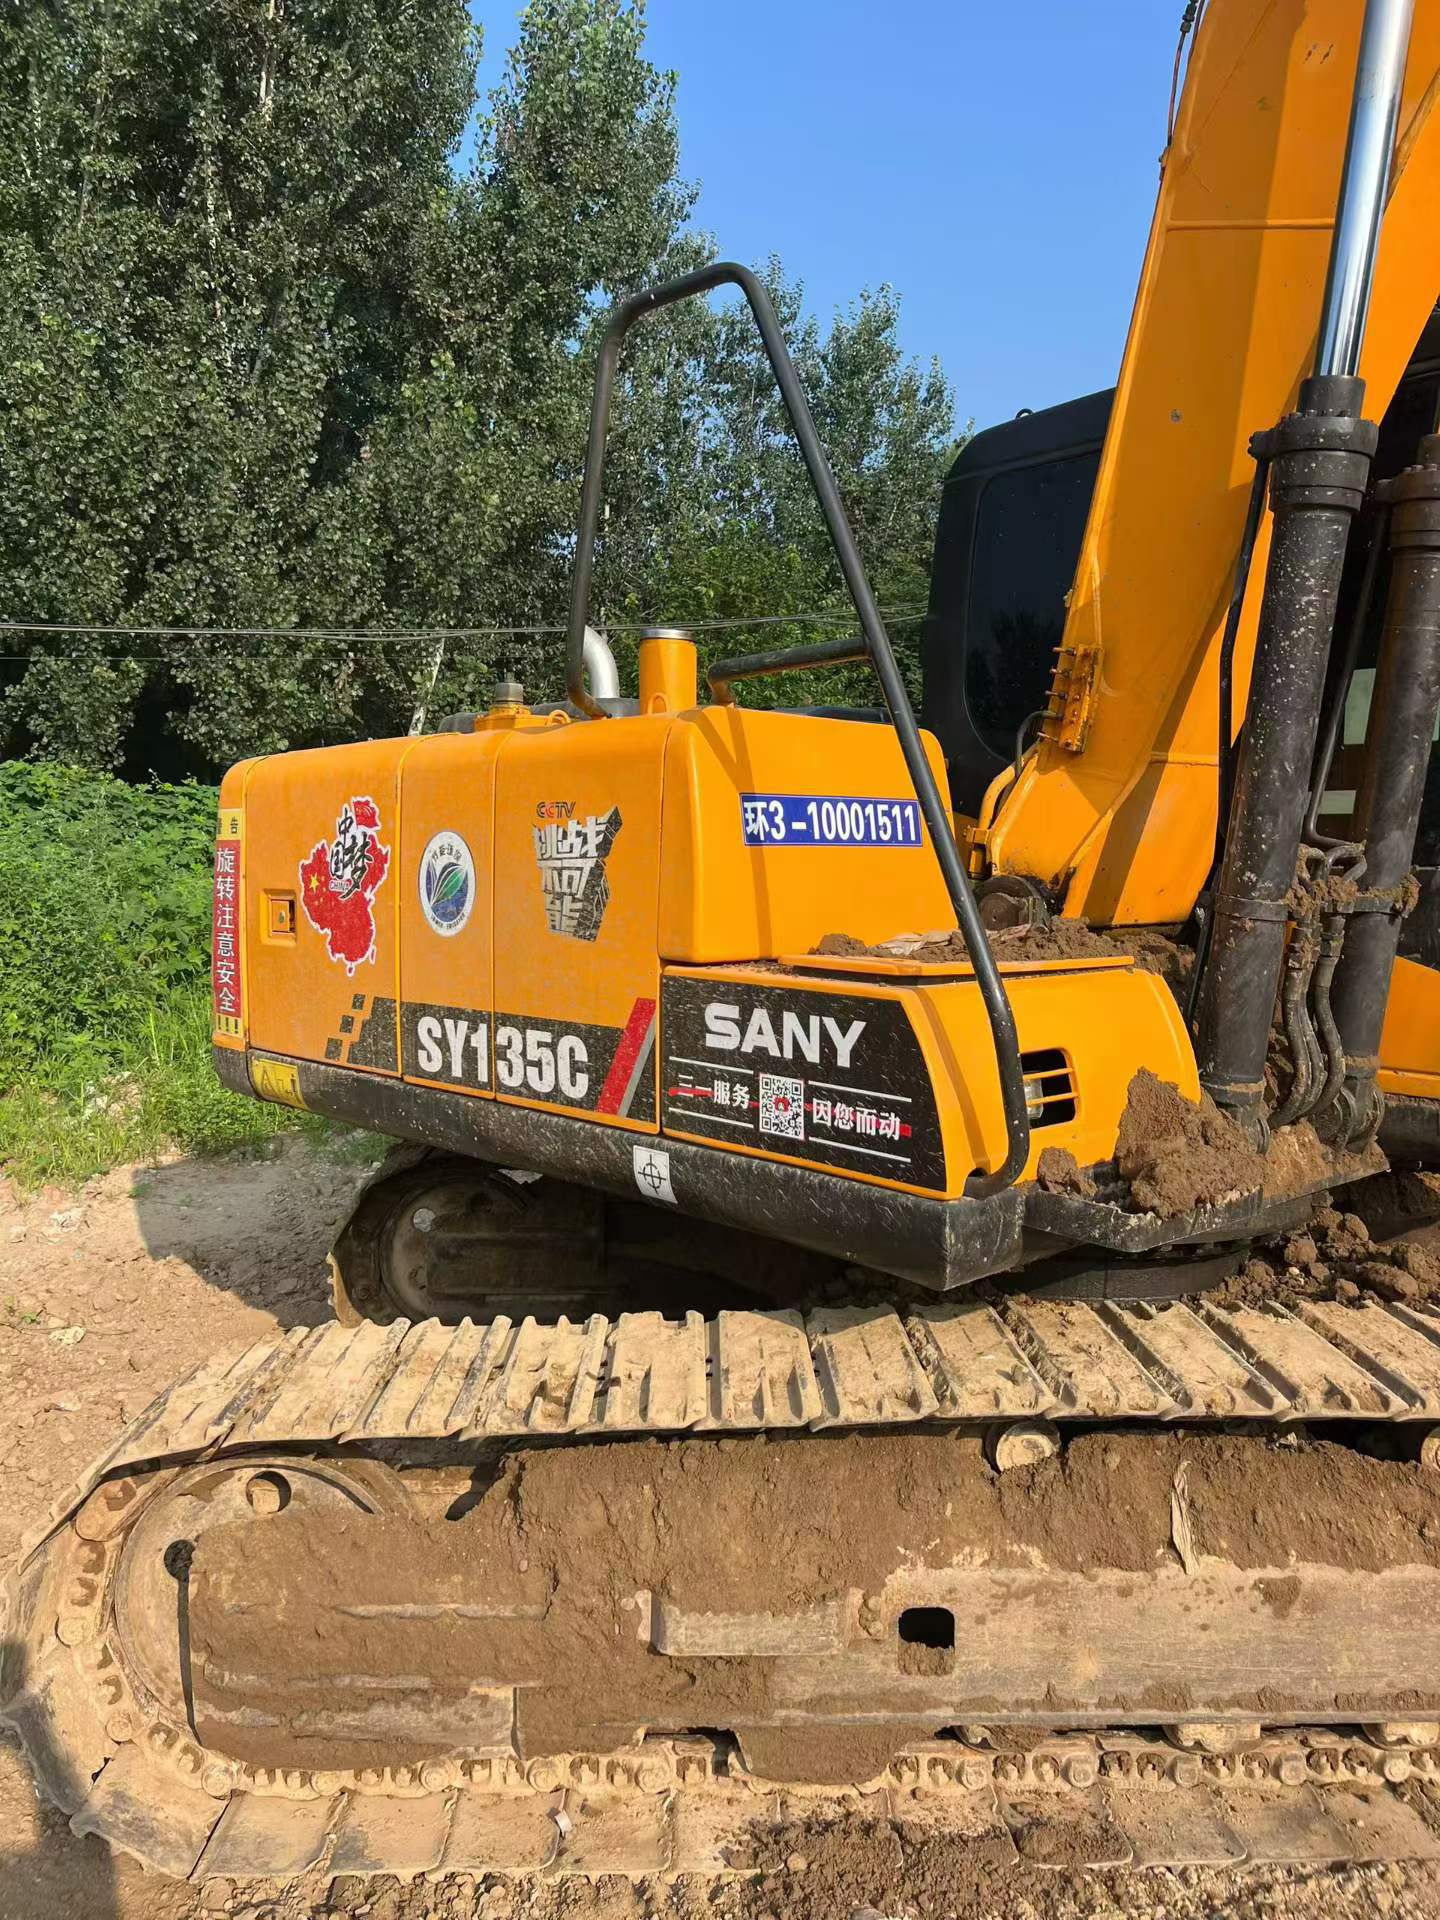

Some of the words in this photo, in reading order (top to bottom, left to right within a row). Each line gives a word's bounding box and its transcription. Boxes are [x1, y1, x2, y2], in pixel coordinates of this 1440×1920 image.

[536, 801, 576, 819] CCTV
[216, 848, 236, 1012] 旋转注意安全
[417, 1016, 589, 1099] SY135C
[704, 1002, 867, 1068] SANY
[678, 1074, 750, 1109] 三一服务
[812, 1098, 901, 1141] 因您而动
